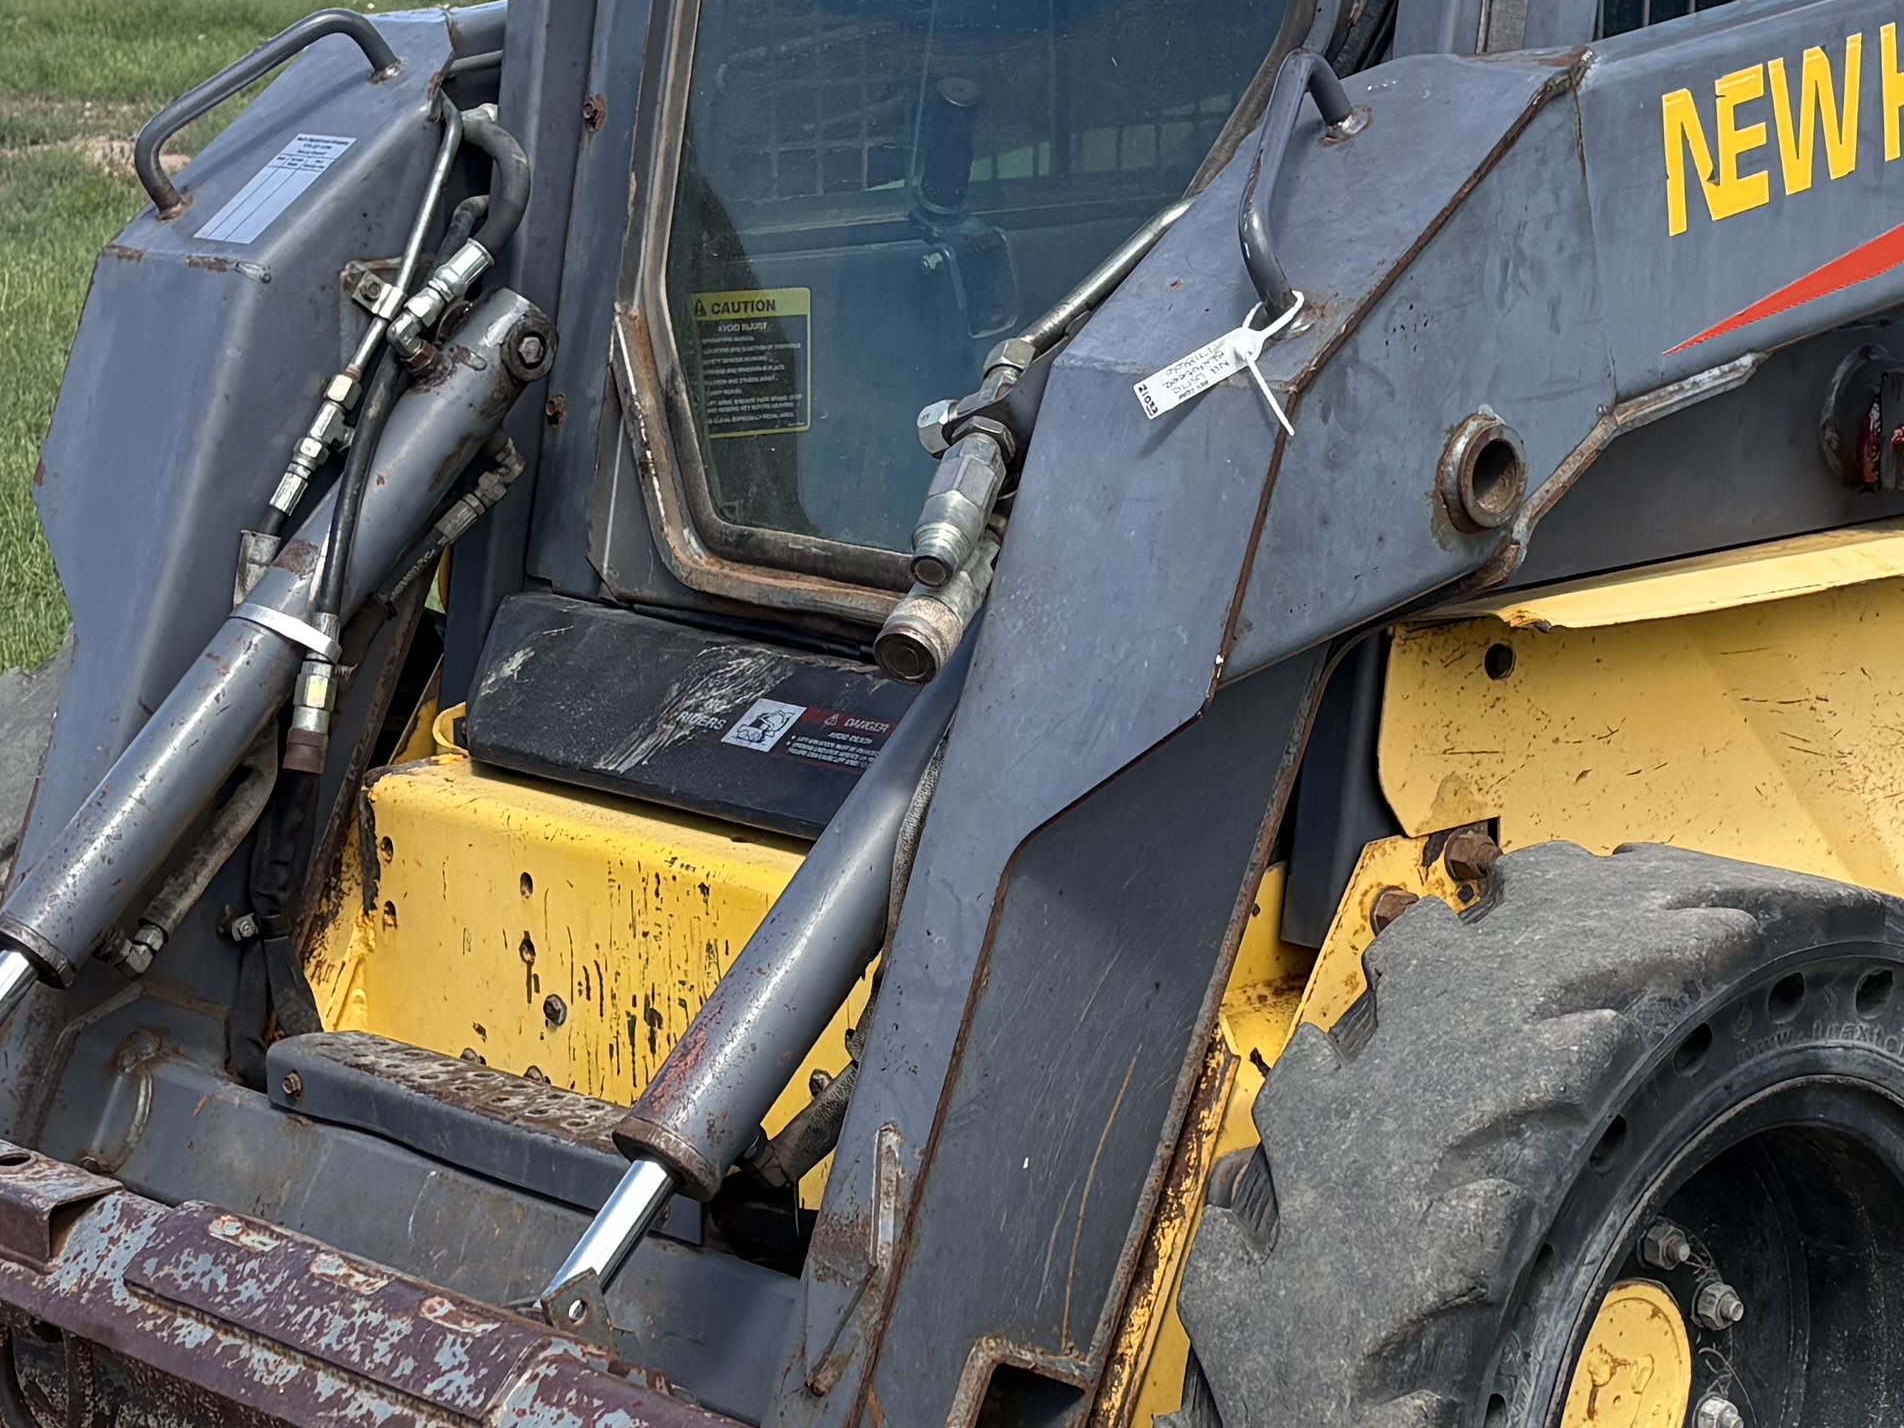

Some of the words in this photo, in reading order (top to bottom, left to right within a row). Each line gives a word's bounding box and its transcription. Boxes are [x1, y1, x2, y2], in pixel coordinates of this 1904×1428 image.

[1662, 31, 1862, 237] NEW
[711, 299, 776, 315] CAUTION
[675, 710, 727, 731] RIDERS
[843, 717, 889, 733] DANGER
